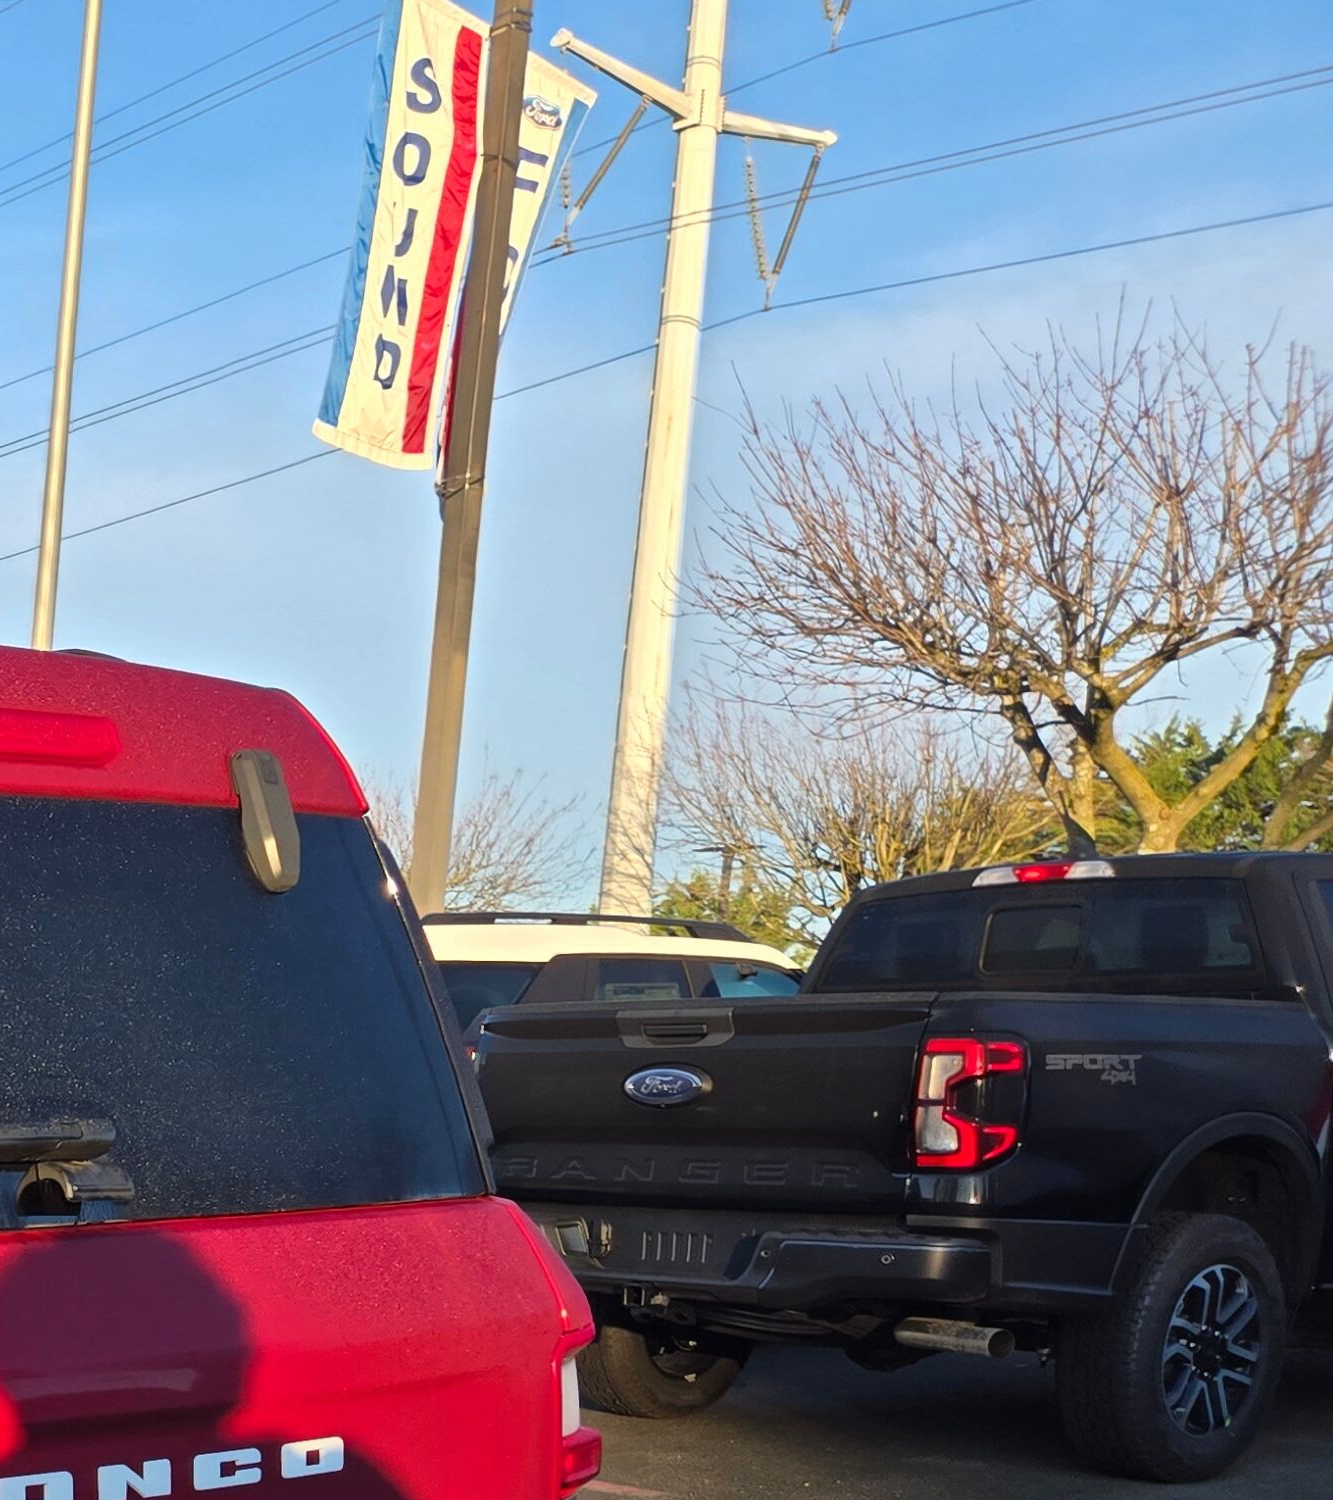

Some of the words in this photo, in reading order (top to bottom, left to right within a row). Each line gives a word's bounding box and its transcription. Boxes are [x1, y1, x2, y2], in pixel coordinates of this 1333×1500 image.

[1044, 1054, 1143, 1070] SPORT
[640, 1074, 684, 1095] Ford
[495, 1155, 862, 1190] RANGER
